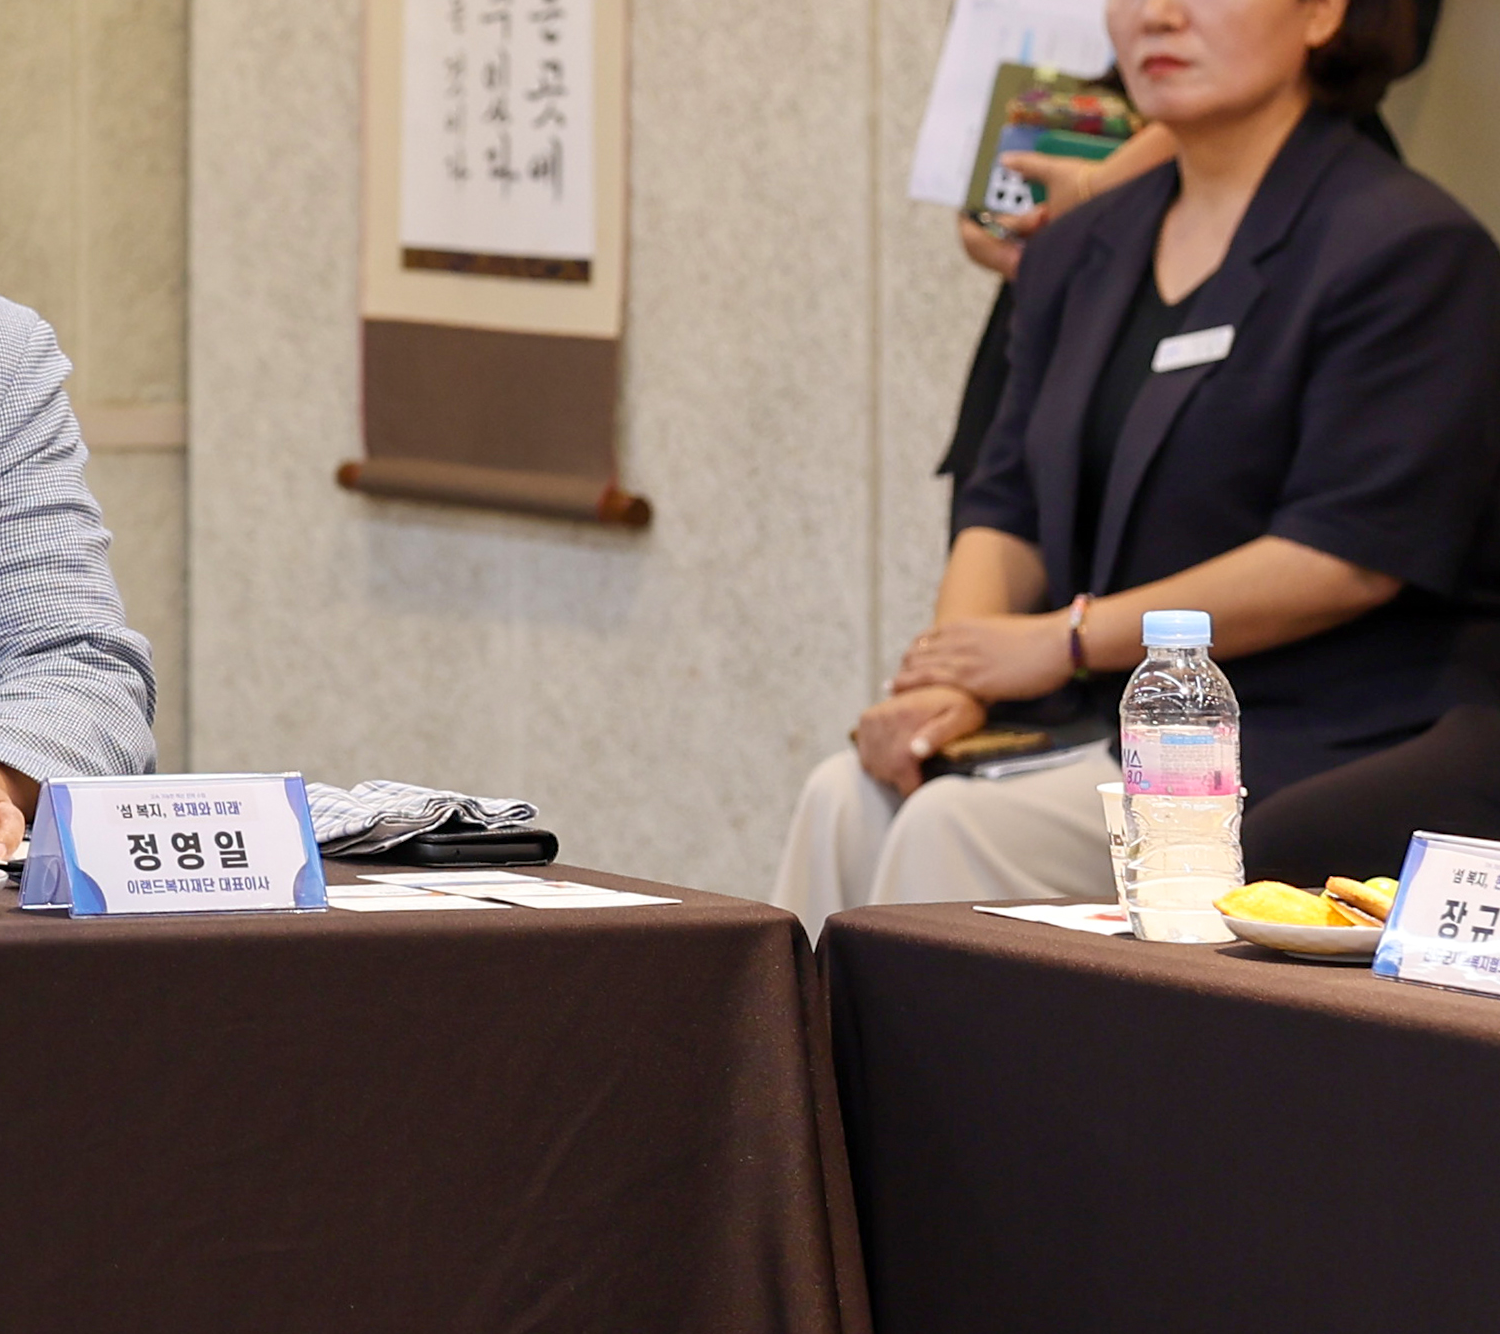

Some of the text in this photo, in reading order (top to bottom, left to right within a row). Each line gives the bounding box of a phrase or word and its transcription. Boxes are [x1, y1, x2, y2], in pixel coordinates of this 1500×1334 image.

[136, 803, 167, 819] 복지,
[172, 802, 211, 818] 현재와
[126, 877, 270, 895] 이랜드복지재단 대표이사
